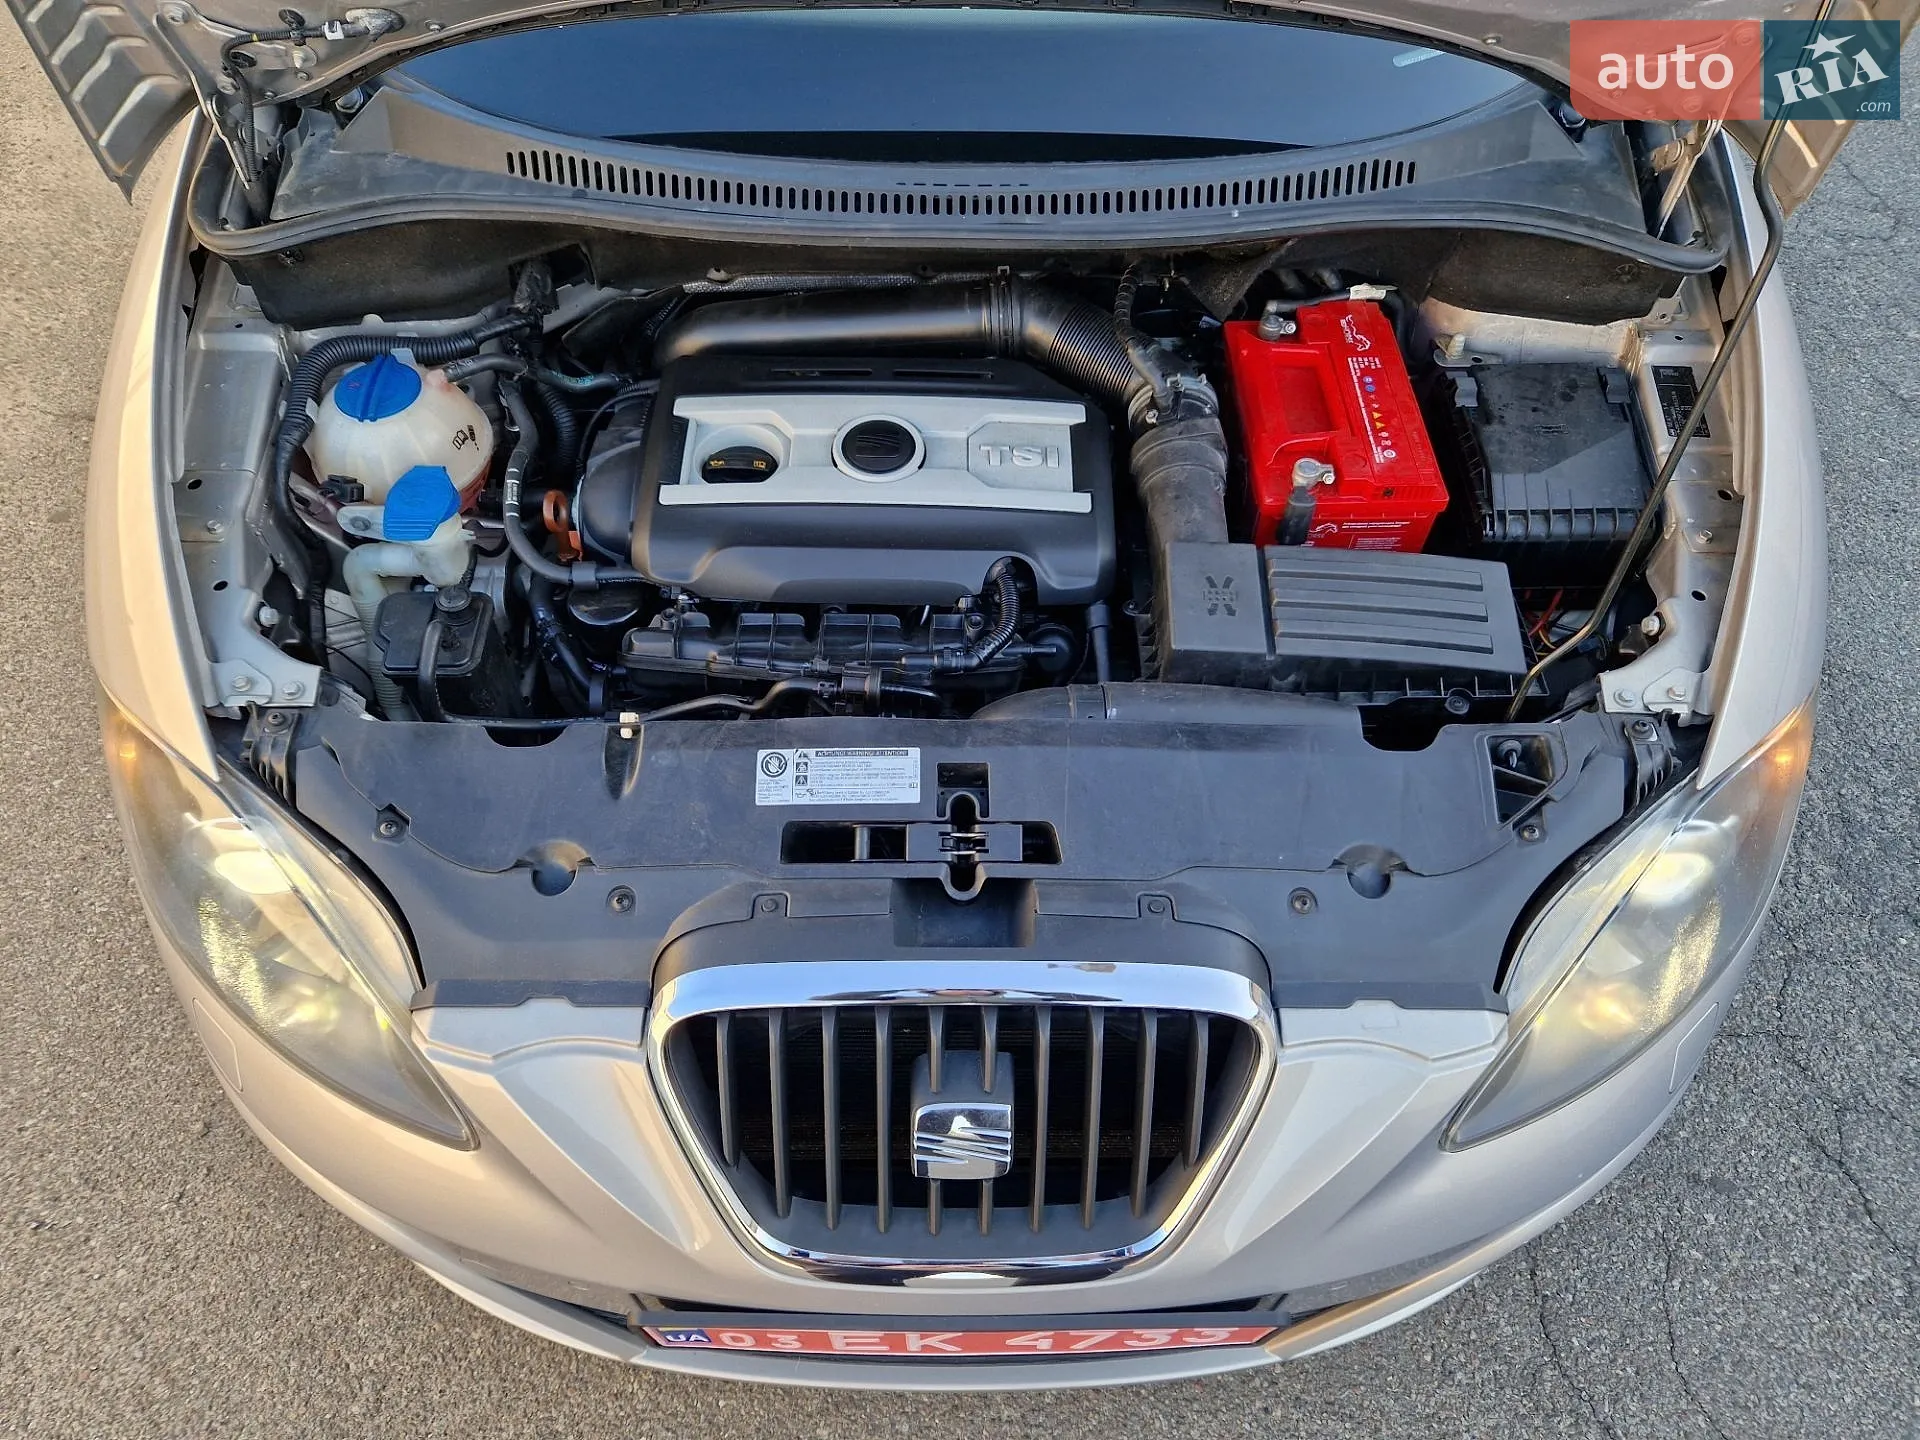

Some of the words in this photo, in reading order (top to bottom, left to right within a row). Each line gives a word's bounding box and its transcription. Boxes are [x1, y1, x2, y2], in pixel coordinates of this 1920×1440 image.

[980, 445, 1060, 468] TSI
[665, 1334, 709, 1342] UA
[719, 1332, 803, 1349] 03
[828, 1331, 963, 1352] EK
[1005, 1327, 1240, 1350] 4733
